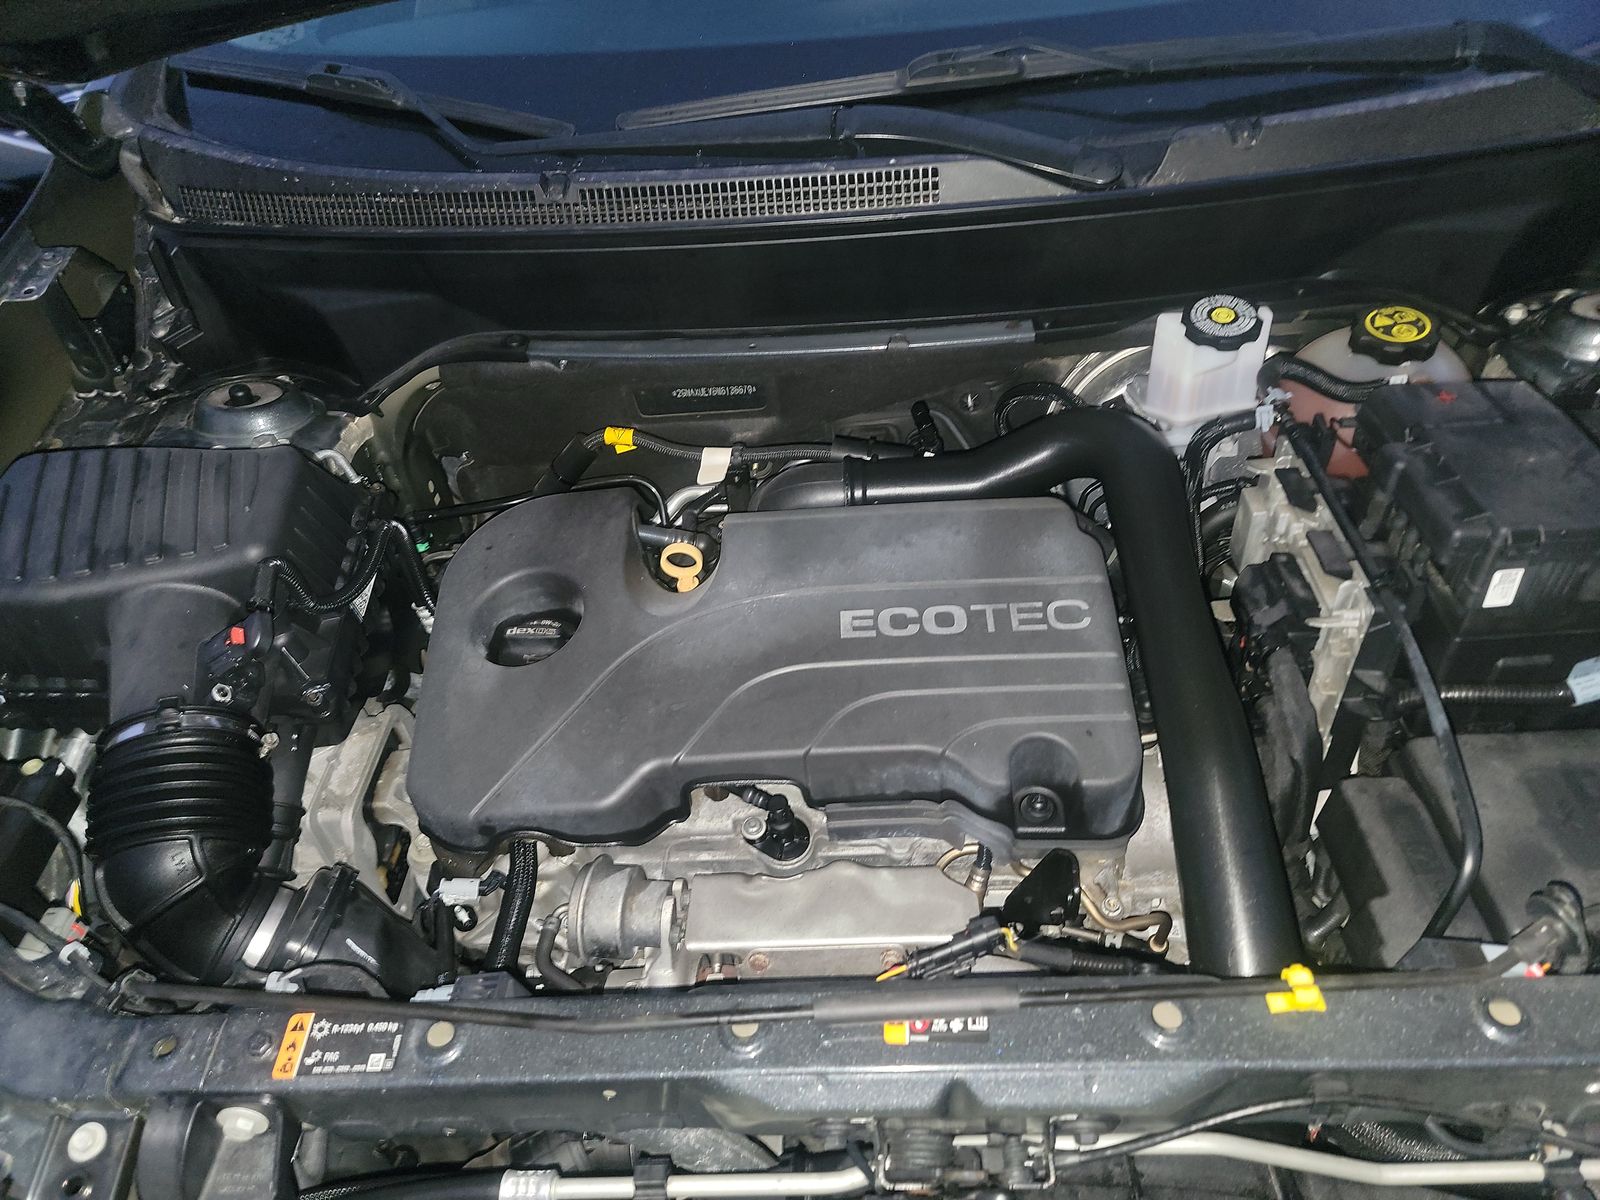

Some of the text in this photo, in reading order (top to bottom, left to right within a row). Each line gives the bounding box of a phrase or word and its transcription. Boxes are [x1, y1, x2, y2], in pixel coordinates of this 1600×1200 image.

[840, 599, 1092, 639] ECOTEC
[505, 626, 557, 636] dexos
[387, 1021, 399, 1033] kg
